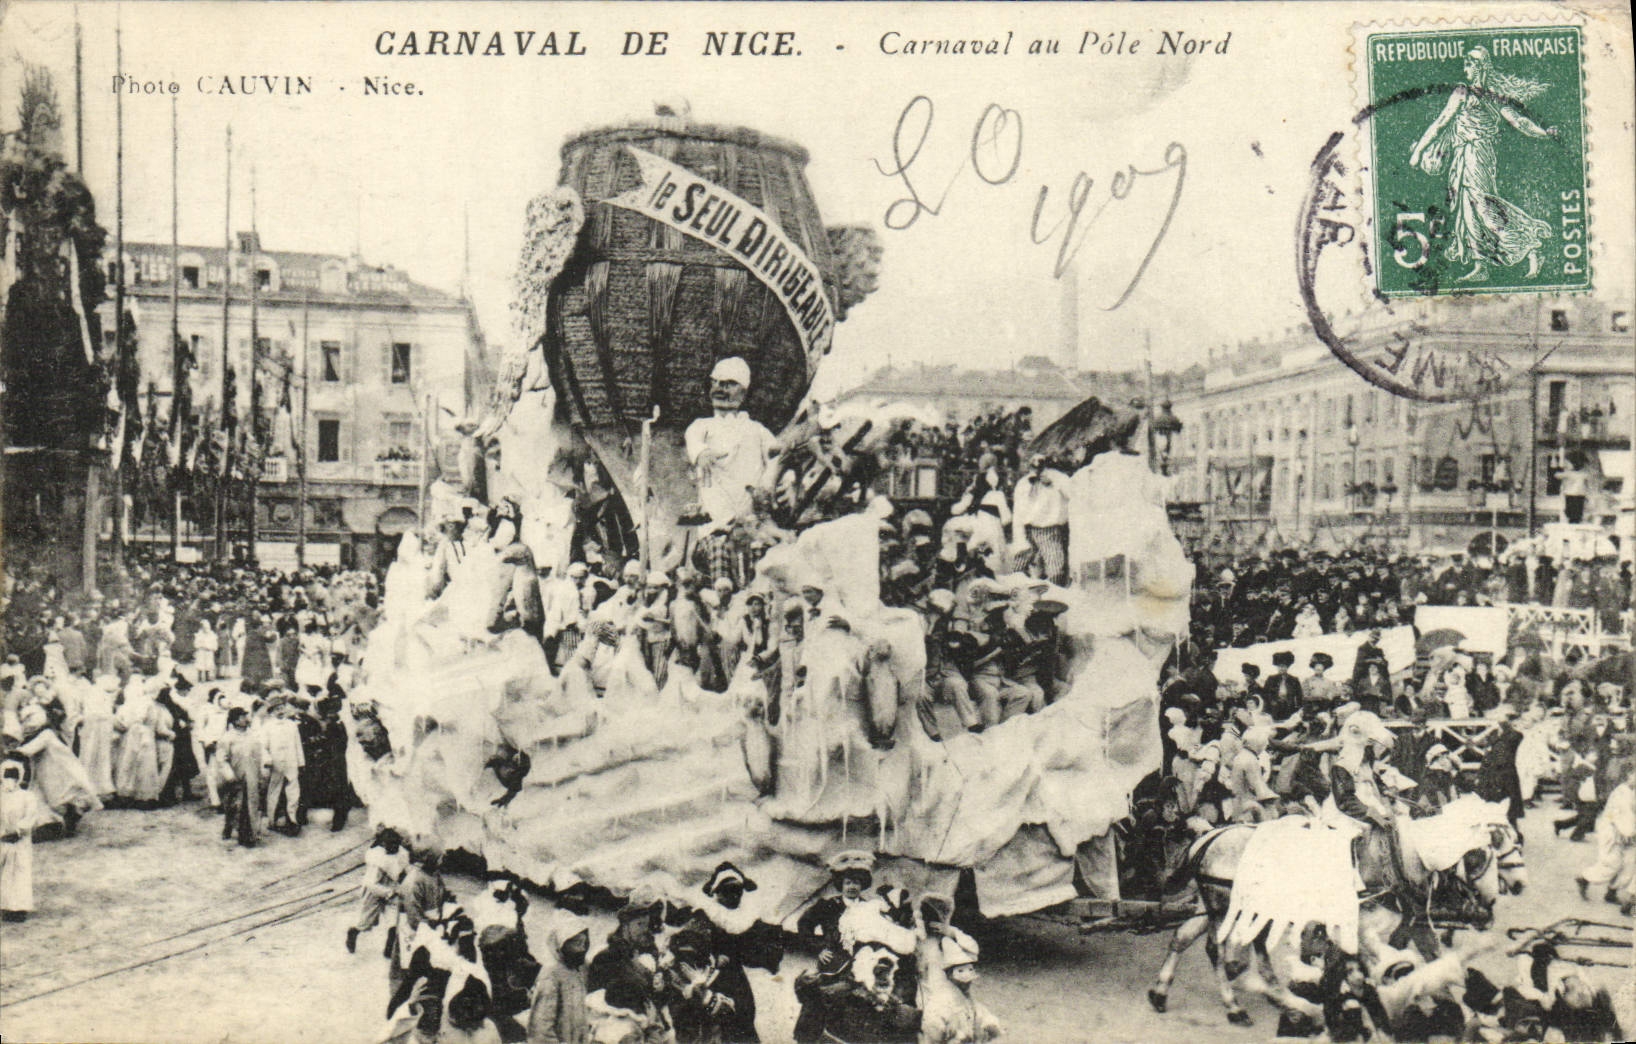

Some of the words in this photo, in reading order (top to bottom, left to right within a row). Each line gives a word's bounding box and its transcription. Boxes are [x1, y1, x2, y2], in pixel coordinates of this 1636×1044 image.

[1492, 36, 1576, 58] FRANÇAISE
[672, 182, 743, 246] SEUL
[1561, 189, 1583, 275] POSTES
